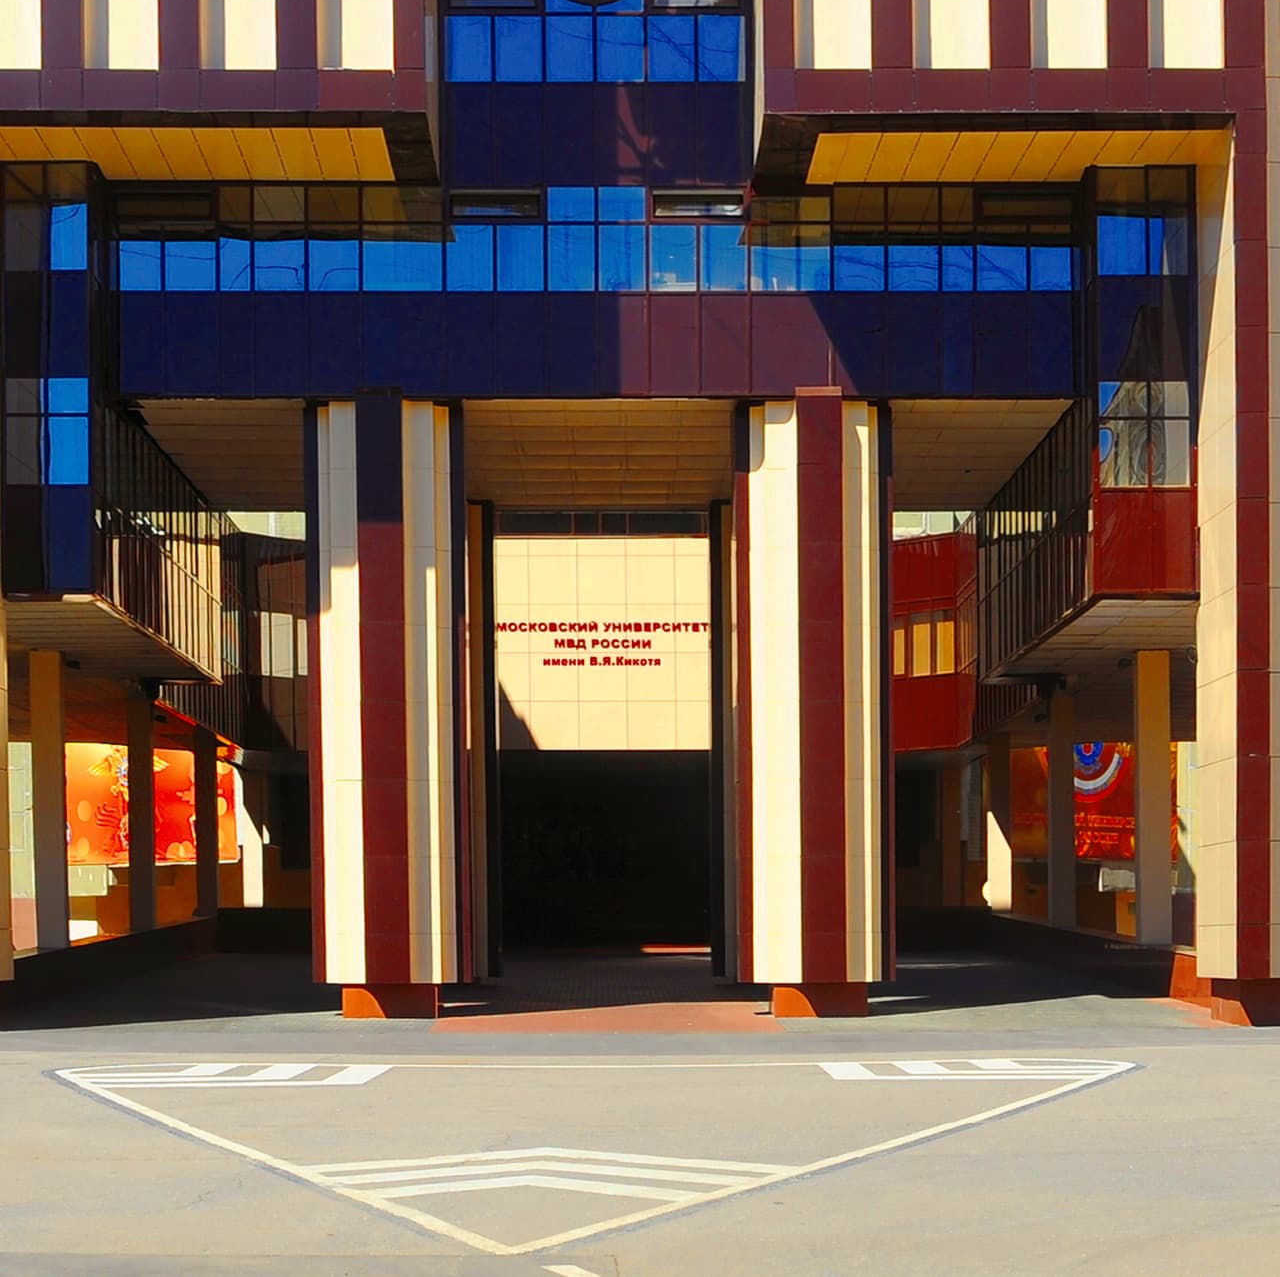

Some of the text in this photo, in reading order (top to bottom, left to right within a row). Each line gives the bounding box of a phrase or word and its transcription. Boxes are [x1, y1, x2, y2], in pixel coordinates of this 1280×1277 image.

[496, 621, 709, 633] МОСКОВСКИЙ УНИВЕРСИТЕТ
[554, 639, 652, 650] МВД РОССИИ
[543, 656, 661, 667] имени В.Я.Кикотя
